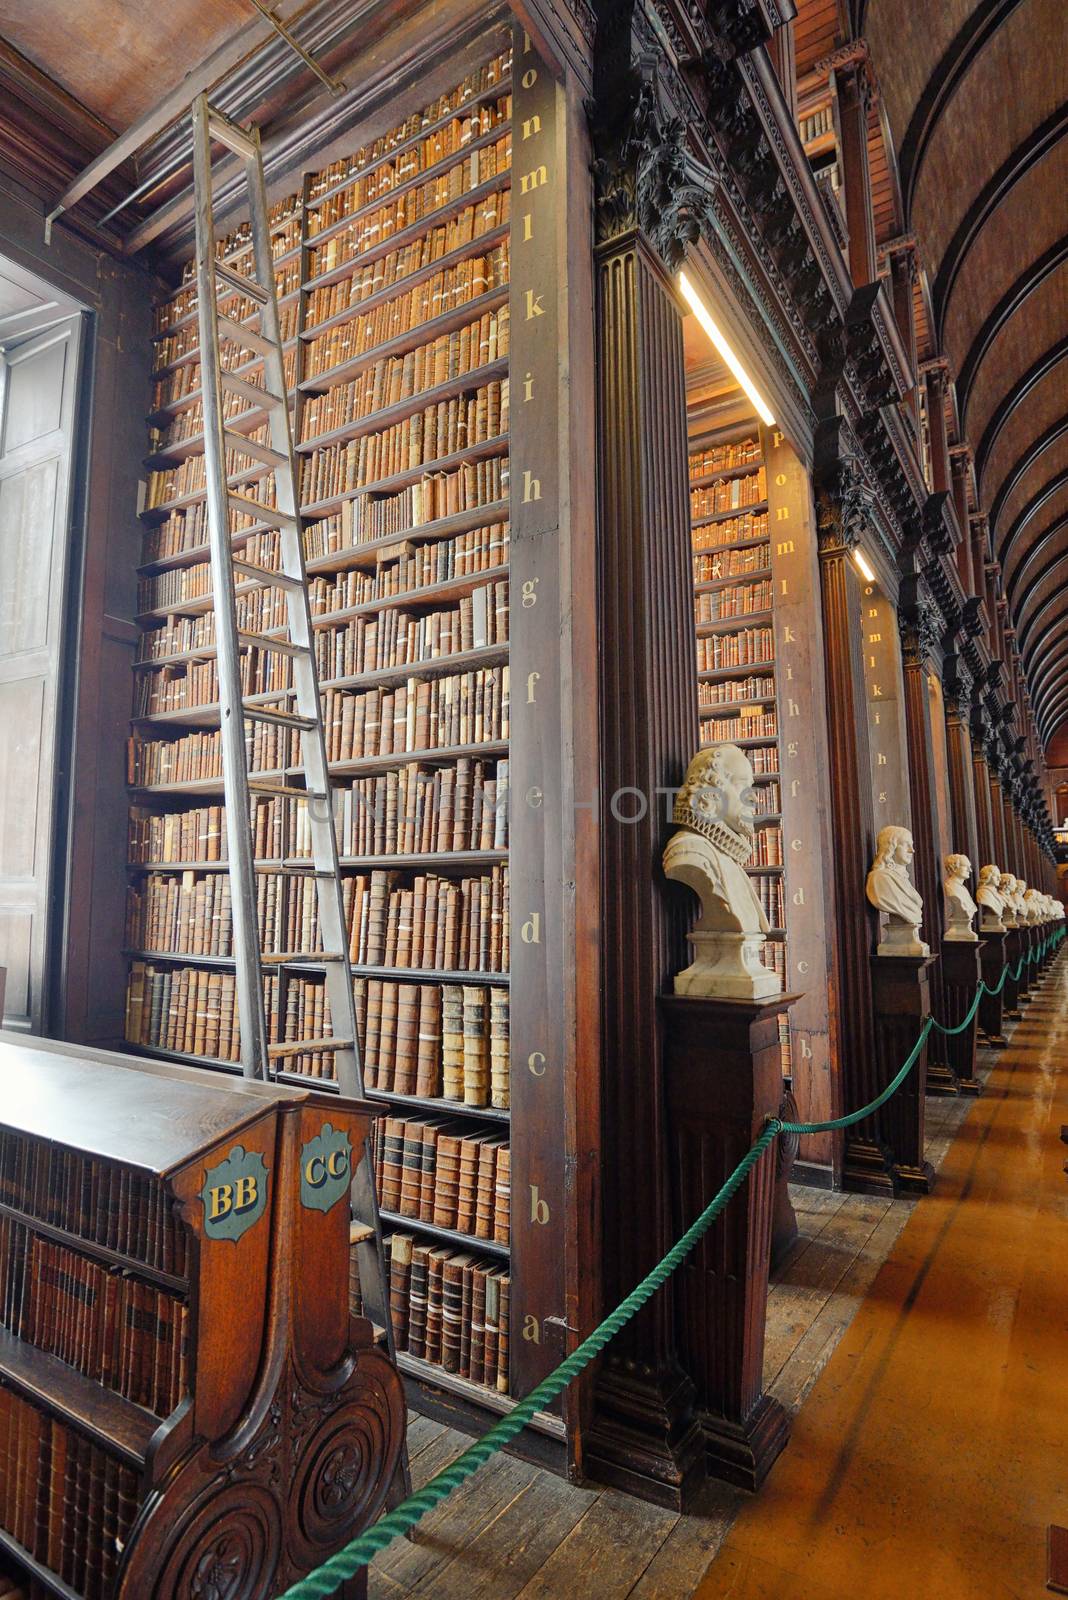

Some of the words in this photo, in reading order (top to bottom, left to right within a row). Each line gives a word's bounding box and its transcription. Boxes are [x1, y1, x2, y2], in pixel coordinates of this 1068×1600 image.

[522, 70, 538, 88] o
[523, 116, 541, 140] n
[520, 166, 548, 194] m
[523, 214, 533, 241] l
[525, 290, 545, 320] k
[523, 373, 534, 401] i
[774, 432, 785, 448] p
[521, 471, 542, 503] h
[776, 474, 786, 485] o
[777, 507, 788, 520] n
[777, 541, 794, 555] m
[522, 578, 541, 608] g
[782, 580, 787, 594] l
[869, 609, 877, 617] n
[784, 627, 795, 642] k
[870, 634, 881, 642] m
[786, 664, 792, 680] i
[525, 672, 540, 704] f
[873, 685, 881, 696] k
[788, 699, 799, 716] h
[788, 742, 798, 757] g
[878, 754, 886, 764] h
[526, 786, 544, 808] e
[792, 780, 799, 797] f
[879, 792, 886, 803] g
[792, 840, 801, 851] e
[793, 888, 804, 905] d
[521, 913, 542, 943] d
[797, 962, 808, 973] c
[800, 1039, 811, 1058] b
[528, 1052, 545, 1076] c
[305, 1147, 348, 1188] CC
[208, 1175, 258, 1224] BB
[529, 1185, 549, 1224] b
[523, 1315, 539, 1344] a
